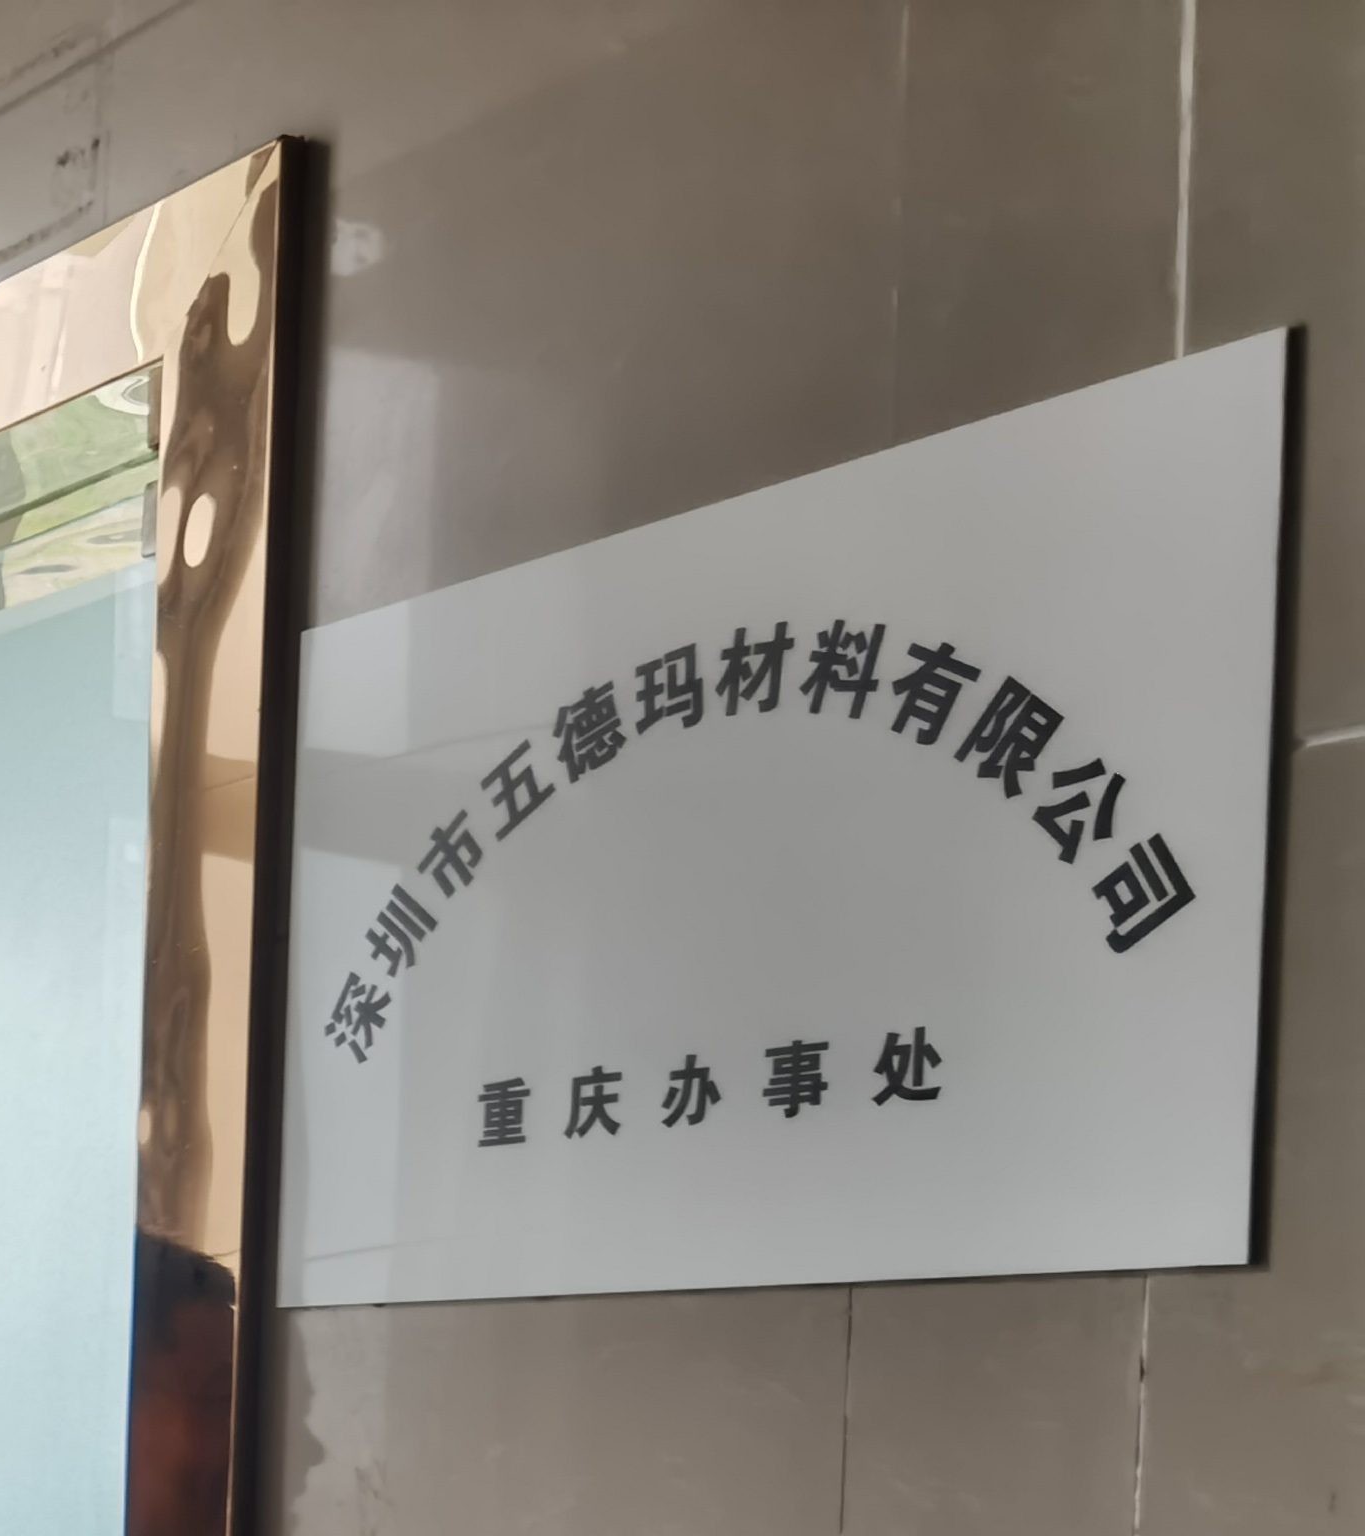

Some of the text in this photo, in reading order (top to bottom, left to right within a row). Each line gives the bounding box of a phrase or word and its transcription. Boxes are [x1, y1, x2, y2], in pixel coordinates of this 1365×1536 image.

[324, 618, 1197, 1064] 深圳市五德玛材料有限公司
[477, 1026, 943, 1148] 重庆办事处
